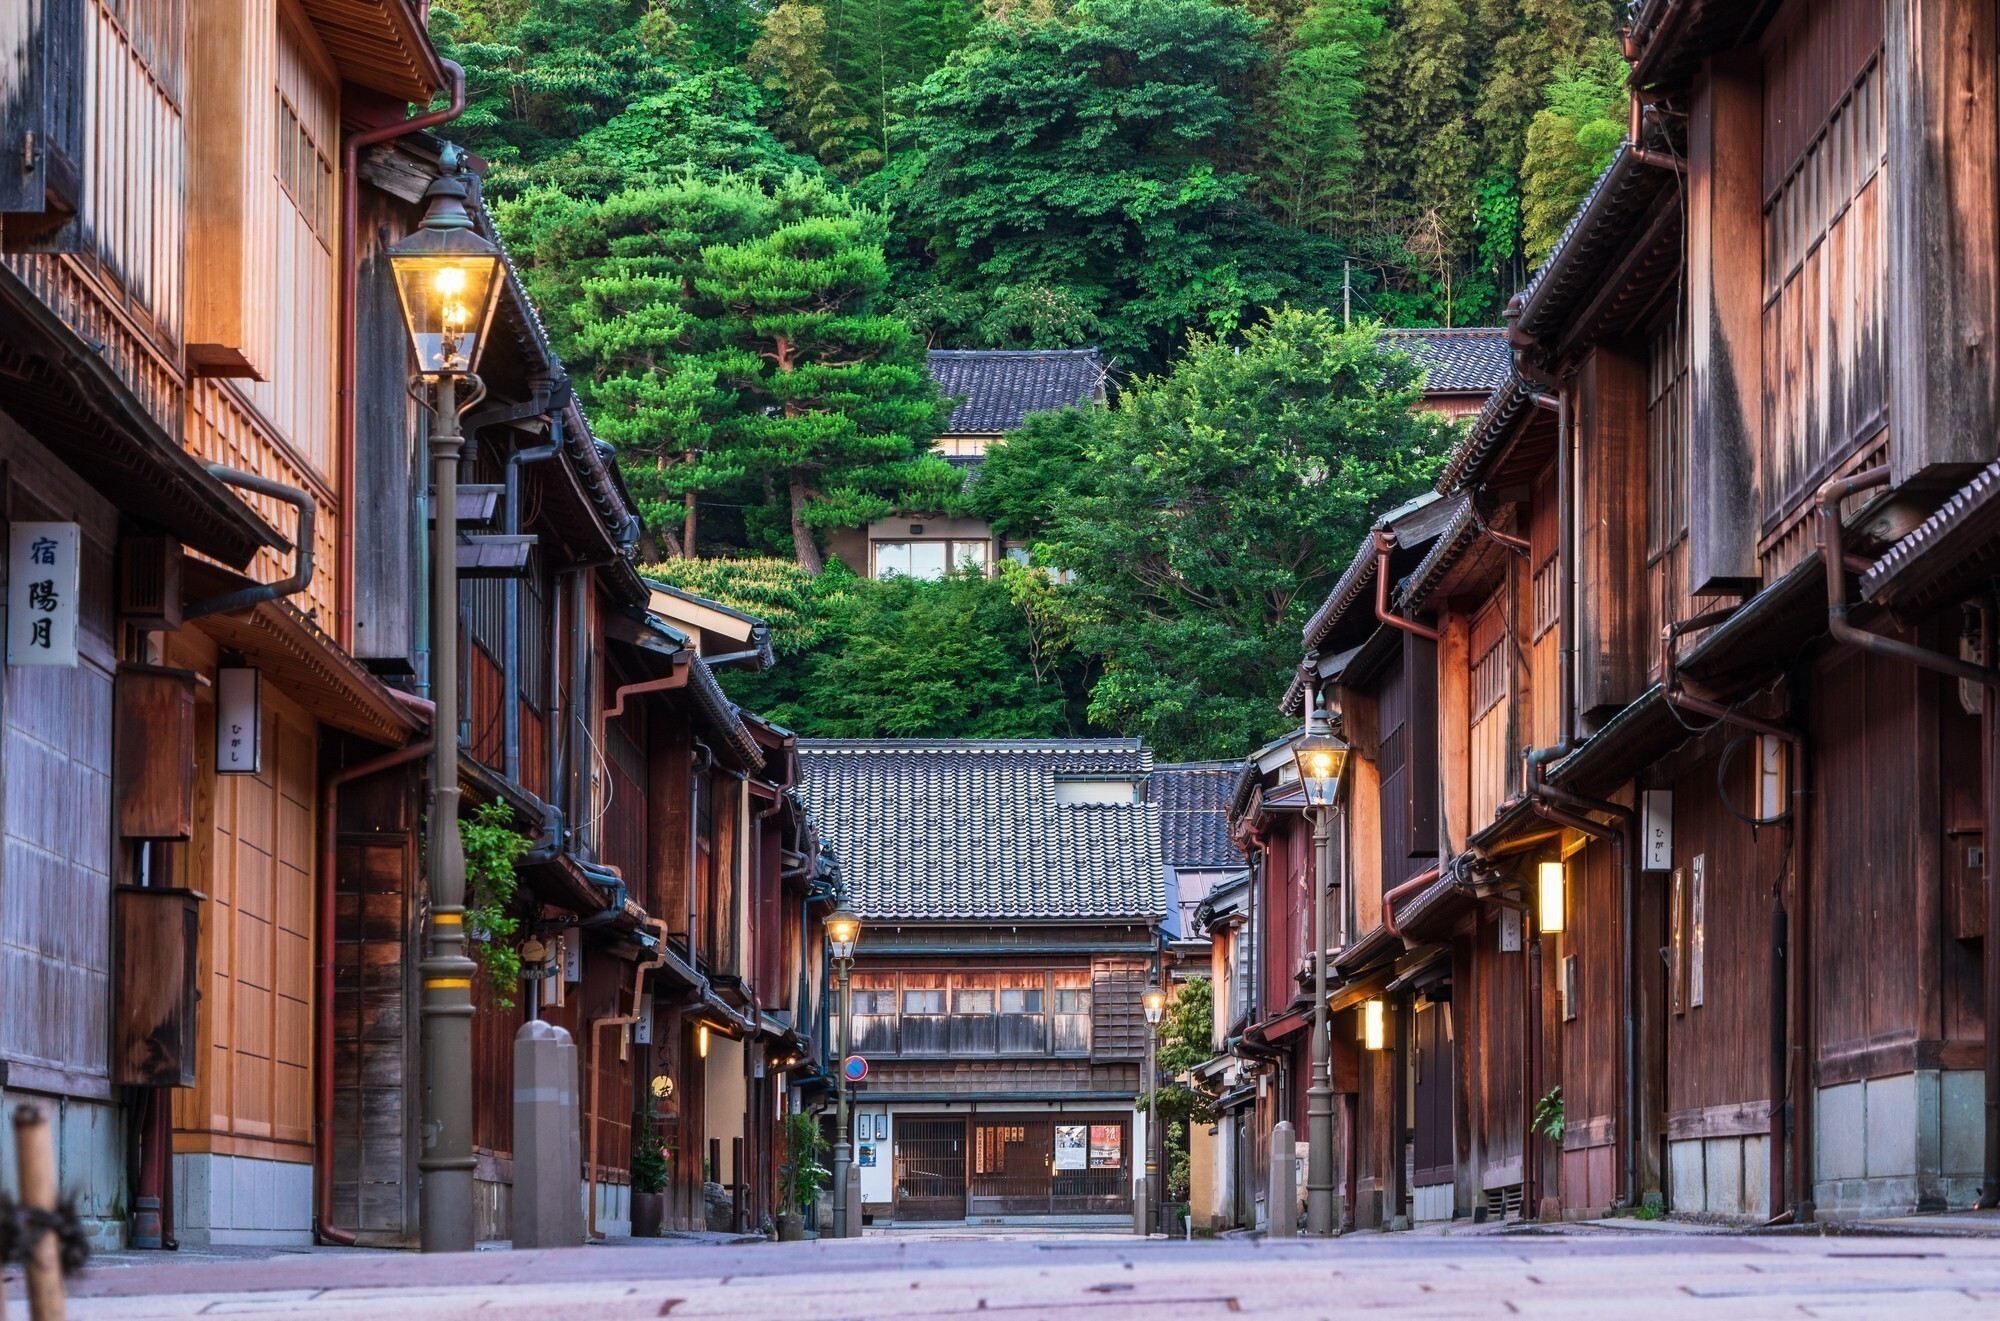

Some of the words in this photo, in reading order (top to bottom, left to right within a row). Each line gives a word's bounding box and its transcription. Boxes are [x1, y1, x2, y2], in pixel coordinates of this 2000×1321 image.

[231, 724, 242, 762] ひがし
[1655, 828, 1664, 863] ひがし
[567, 951, 575, 977] ひがし
